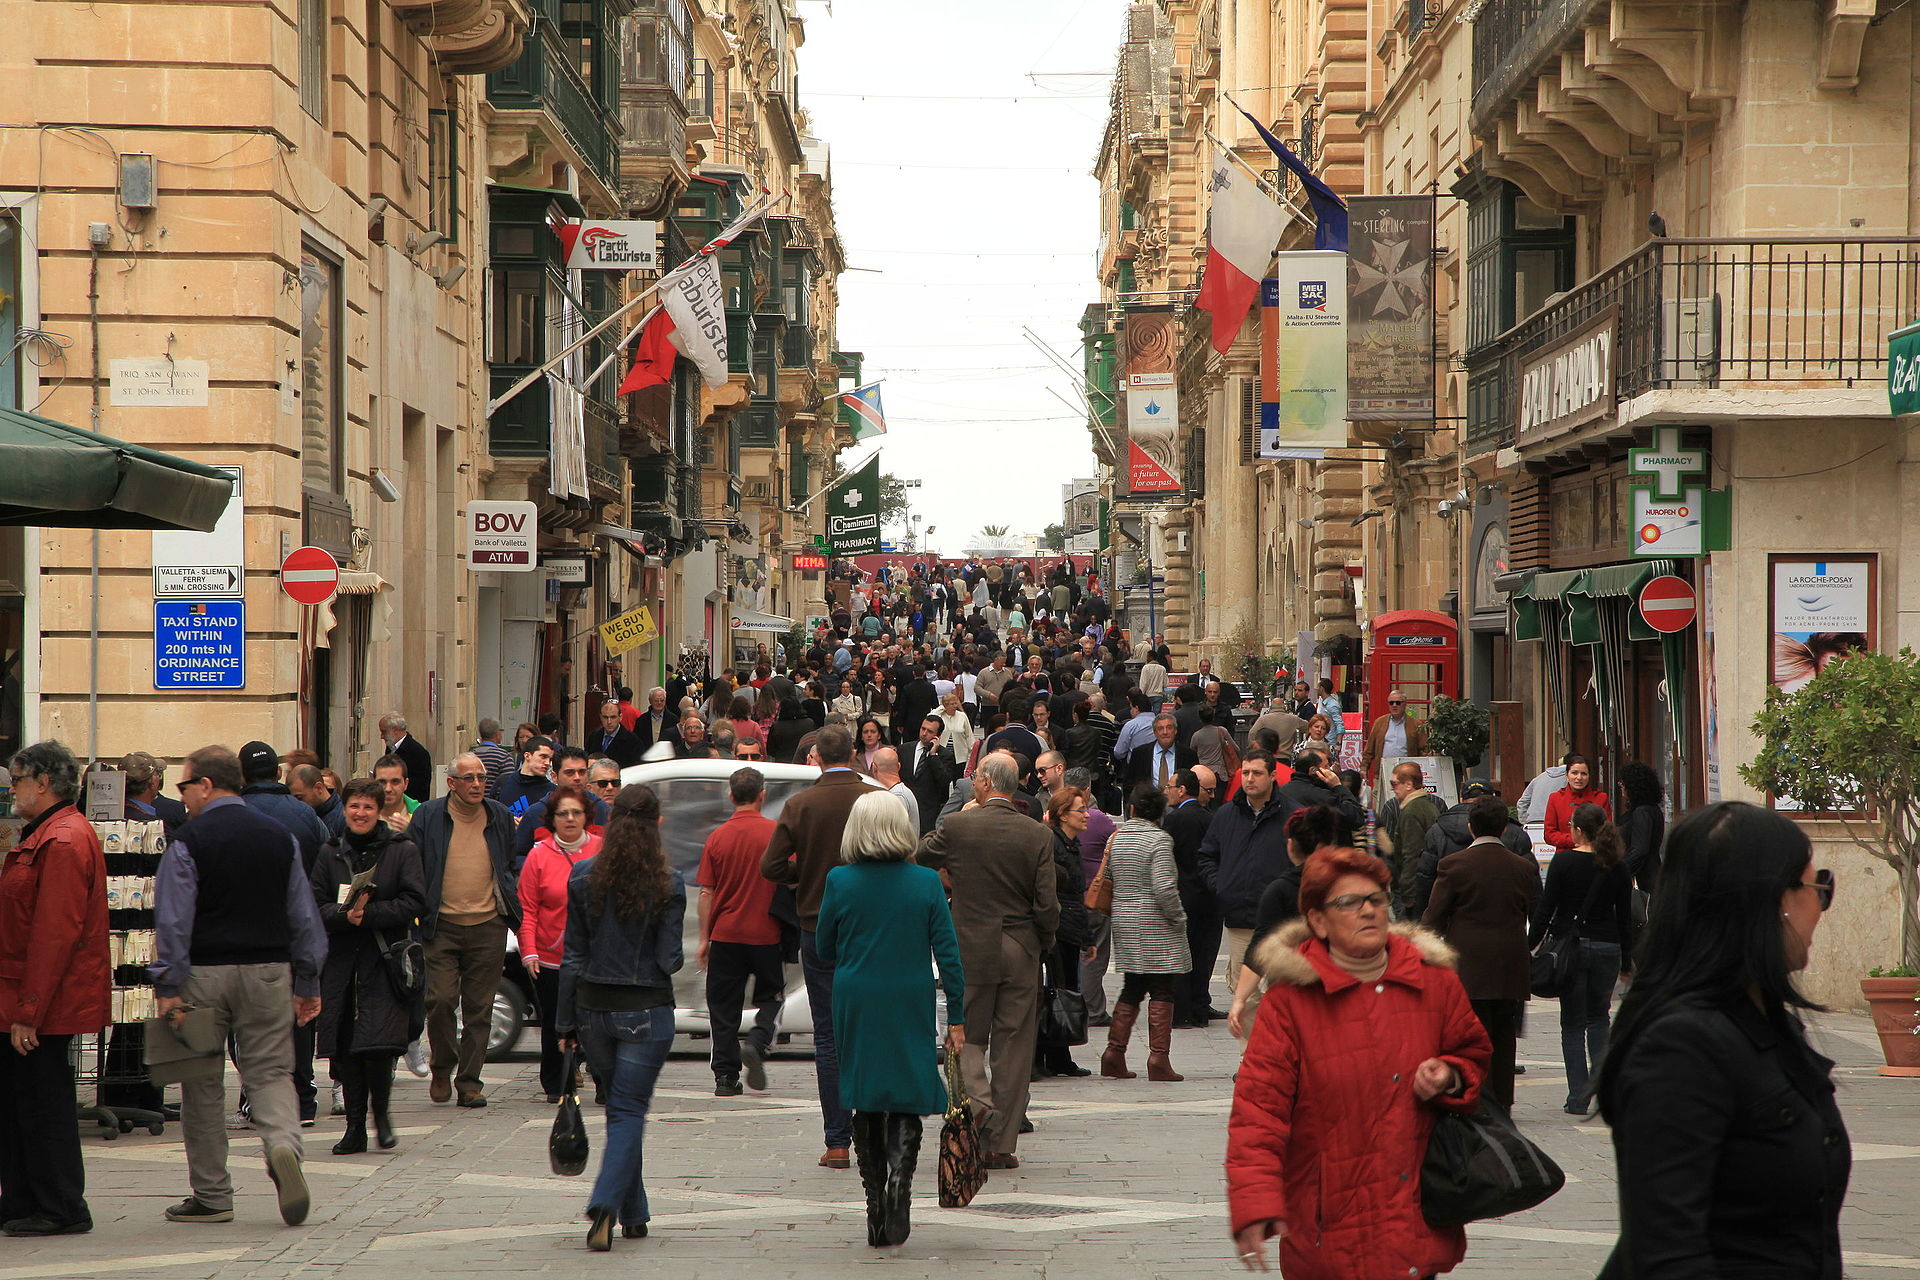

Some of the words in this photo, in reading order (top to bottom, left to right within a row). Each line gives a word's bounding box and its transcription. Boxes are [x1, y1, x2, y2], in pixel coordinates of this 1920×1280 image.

[1364, 220, 1404, 234] STERLING
[599, 240, 628, 251] Partit
[599, 250, 651, 262] Laburista
[677, 268, 728, 363] aburista
[1379, 322, 1420, 332] MALTESE
[1384, 334, 1416, 342] CROSS
[120, 370, 139, 378] TRIQ
[138, 388, 160, 396] JOHN
[1138, 470, 1160, 480] future
[1134, 480, 1144, 488] for
[1158, 480, 1172, 488] past
[474, 513, 527, 532] BOV
[834, 518, 874, 532] Chemimart
[834, 536, 878, 548] PHARMACY
[488, 552, 514, 562] ATM
[795, 557, 825, 568] MIMA
[161, 617, 189, 627] TAXI
[193, 617, 238, 627] STAND
[604, 622, 623, 635] WE
[623, 611, 645, 628] BUY
[175, 631, 222, 640] WITHIN
[614, 624, 645, 642] GOLD
[166, 644, 188, 654] 200
[192, 645, 215, 654] mts
[219, 644, 232, 654] IN
[158, 658, 239, 668] ORDINANCE
[172, 672, 225, 682] STREET
[1344, 742, 1356, 756] 5
